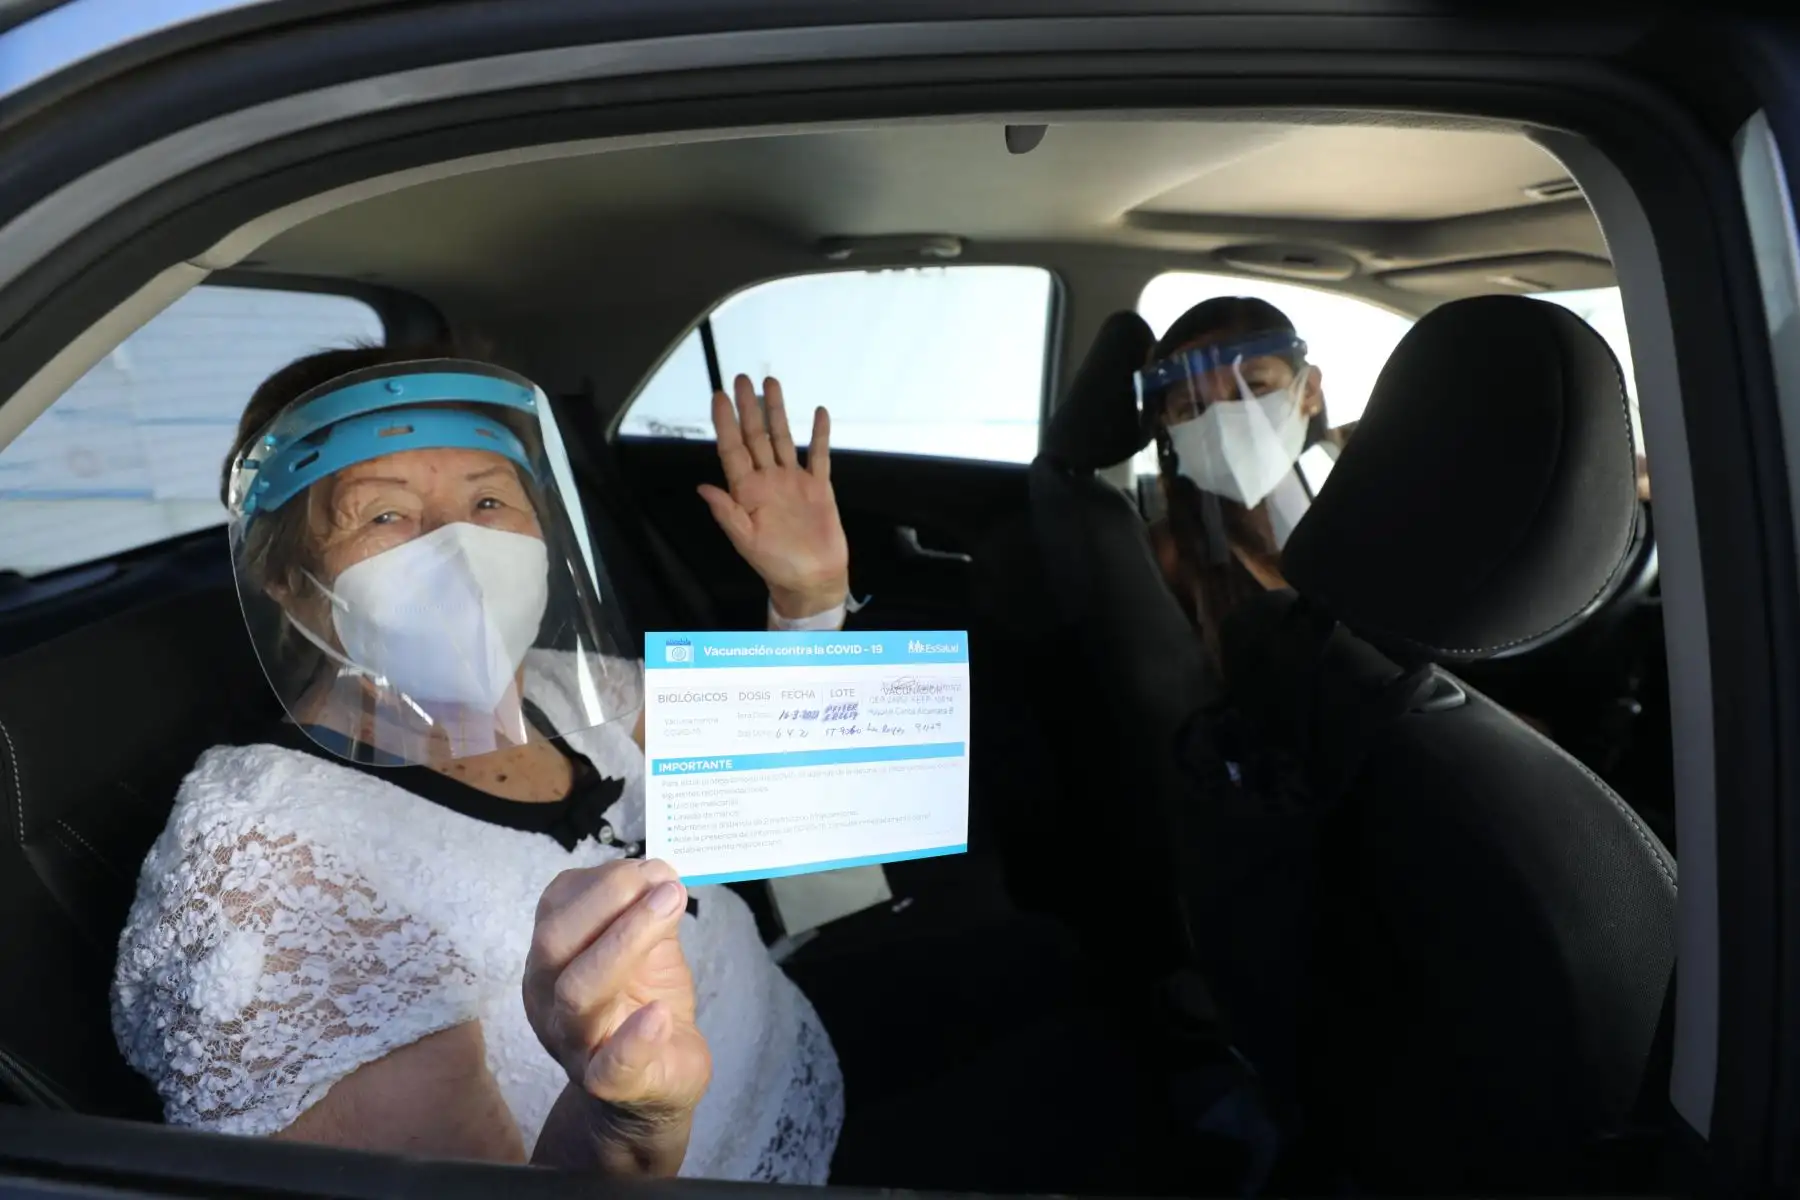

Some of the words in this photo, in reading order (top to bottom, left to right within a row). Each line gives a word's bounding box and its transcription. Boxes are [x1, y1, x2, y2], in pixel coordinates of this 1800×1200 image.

[704, 643, 773, 657] Vacunación
[775, 646, 812, 656] contra
[814, 644, 823, 655] la
[825, 644, 862, 655] COVID
[871, 644, 883, 655] 19
[926, 643, 959, 653] EsSalud
[657, 691, 728, 703] BIOLÓGICOS
[739, 691, 771, 701] DOSIS
[781, 689, 816, 701] FECHA
[830, 689, 856, 698] LOTE
[659, 759, 733, 773] IMPORTANTE
